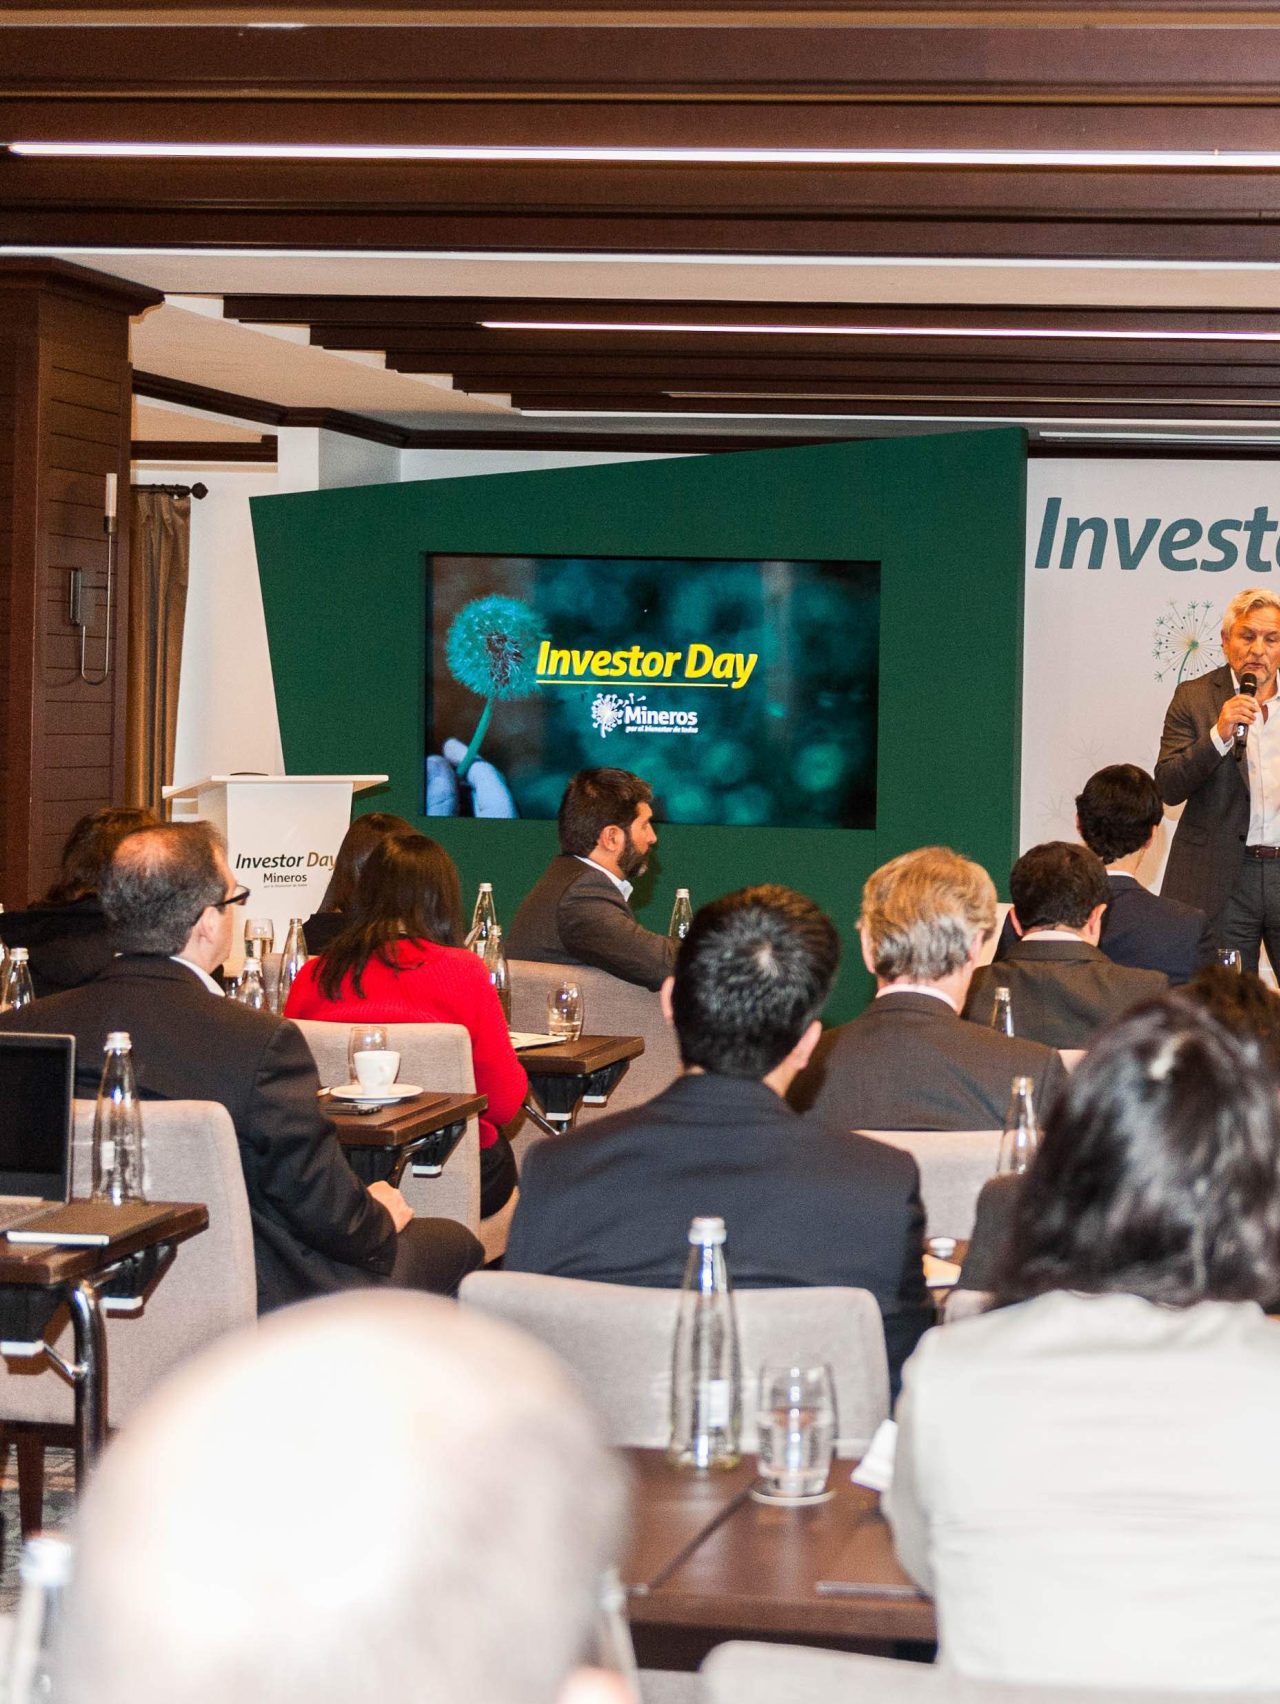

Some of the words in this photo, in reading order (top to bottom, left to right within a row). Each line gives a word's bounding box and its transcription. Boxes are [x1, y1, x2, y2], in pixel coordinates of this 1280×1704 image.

[536, 641, 682, 678] Investor
[685, 643, 758, 689] Day
[624, 706, 698, 725] Mineros
[235, 853, 304, 869] Investor
[263, 873, 308, 883] Mineros
